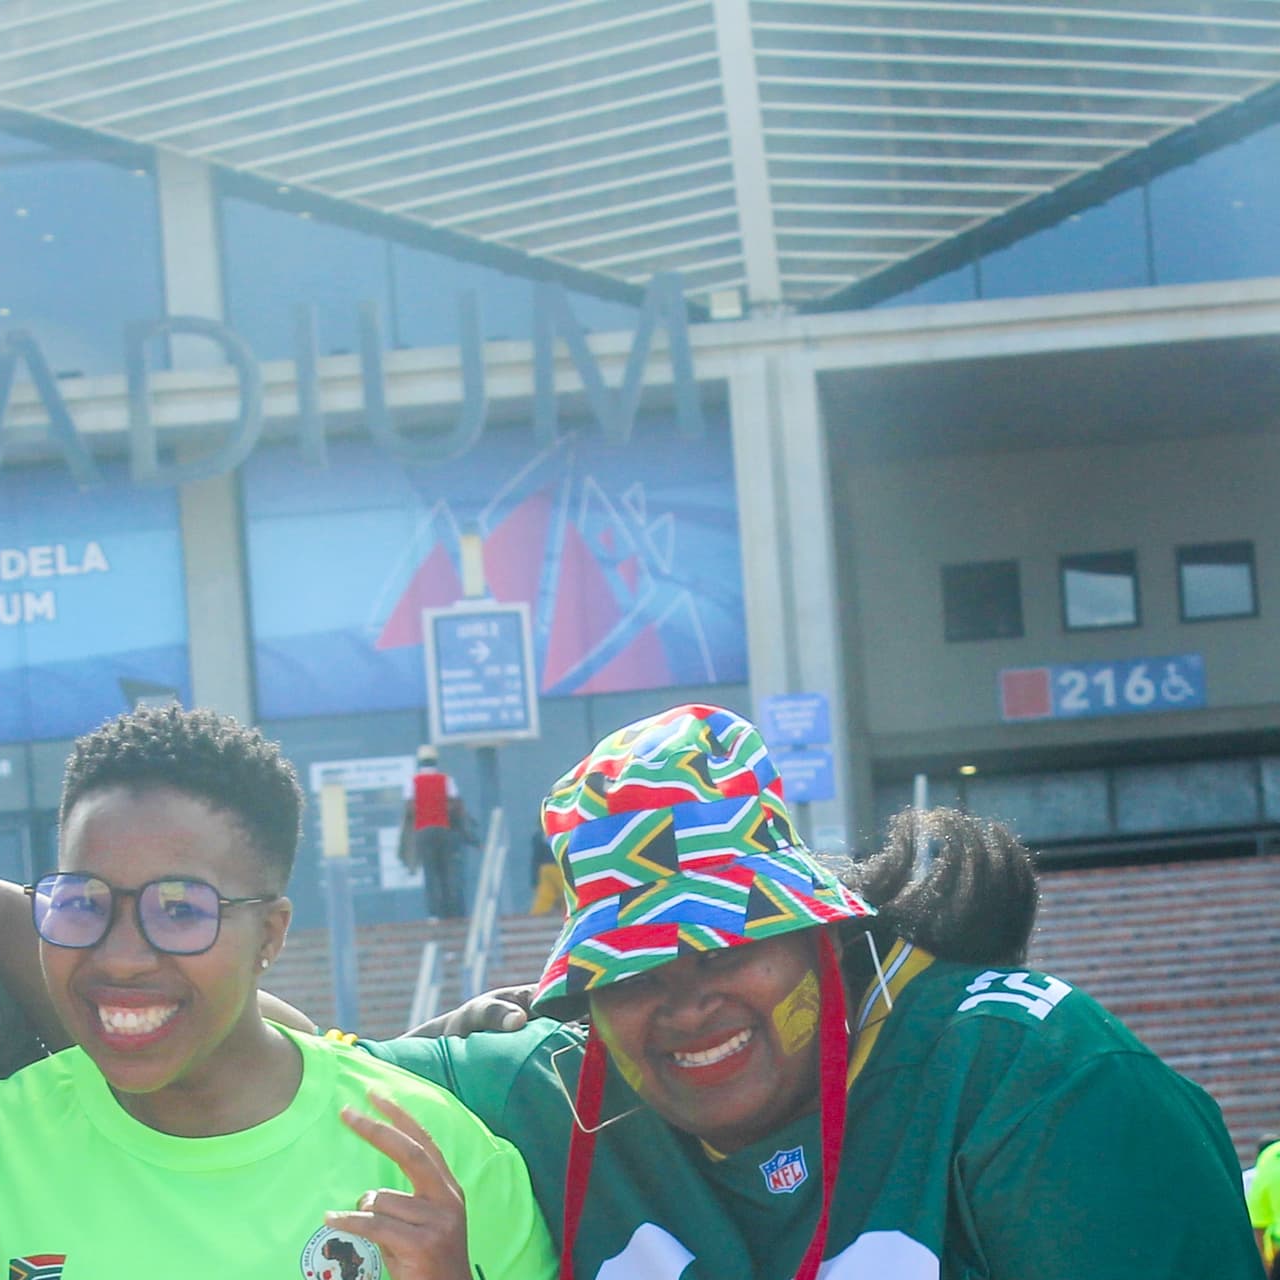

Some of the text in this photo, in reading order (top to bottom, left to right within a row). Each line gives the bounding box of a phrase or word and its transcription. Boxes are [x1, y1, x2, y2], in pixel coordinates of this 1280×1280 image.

[1057, 664, 1156, 710] 216
[957, 970, 1073, 1021] 12
[770, 1163, 803, 1189] NFL
